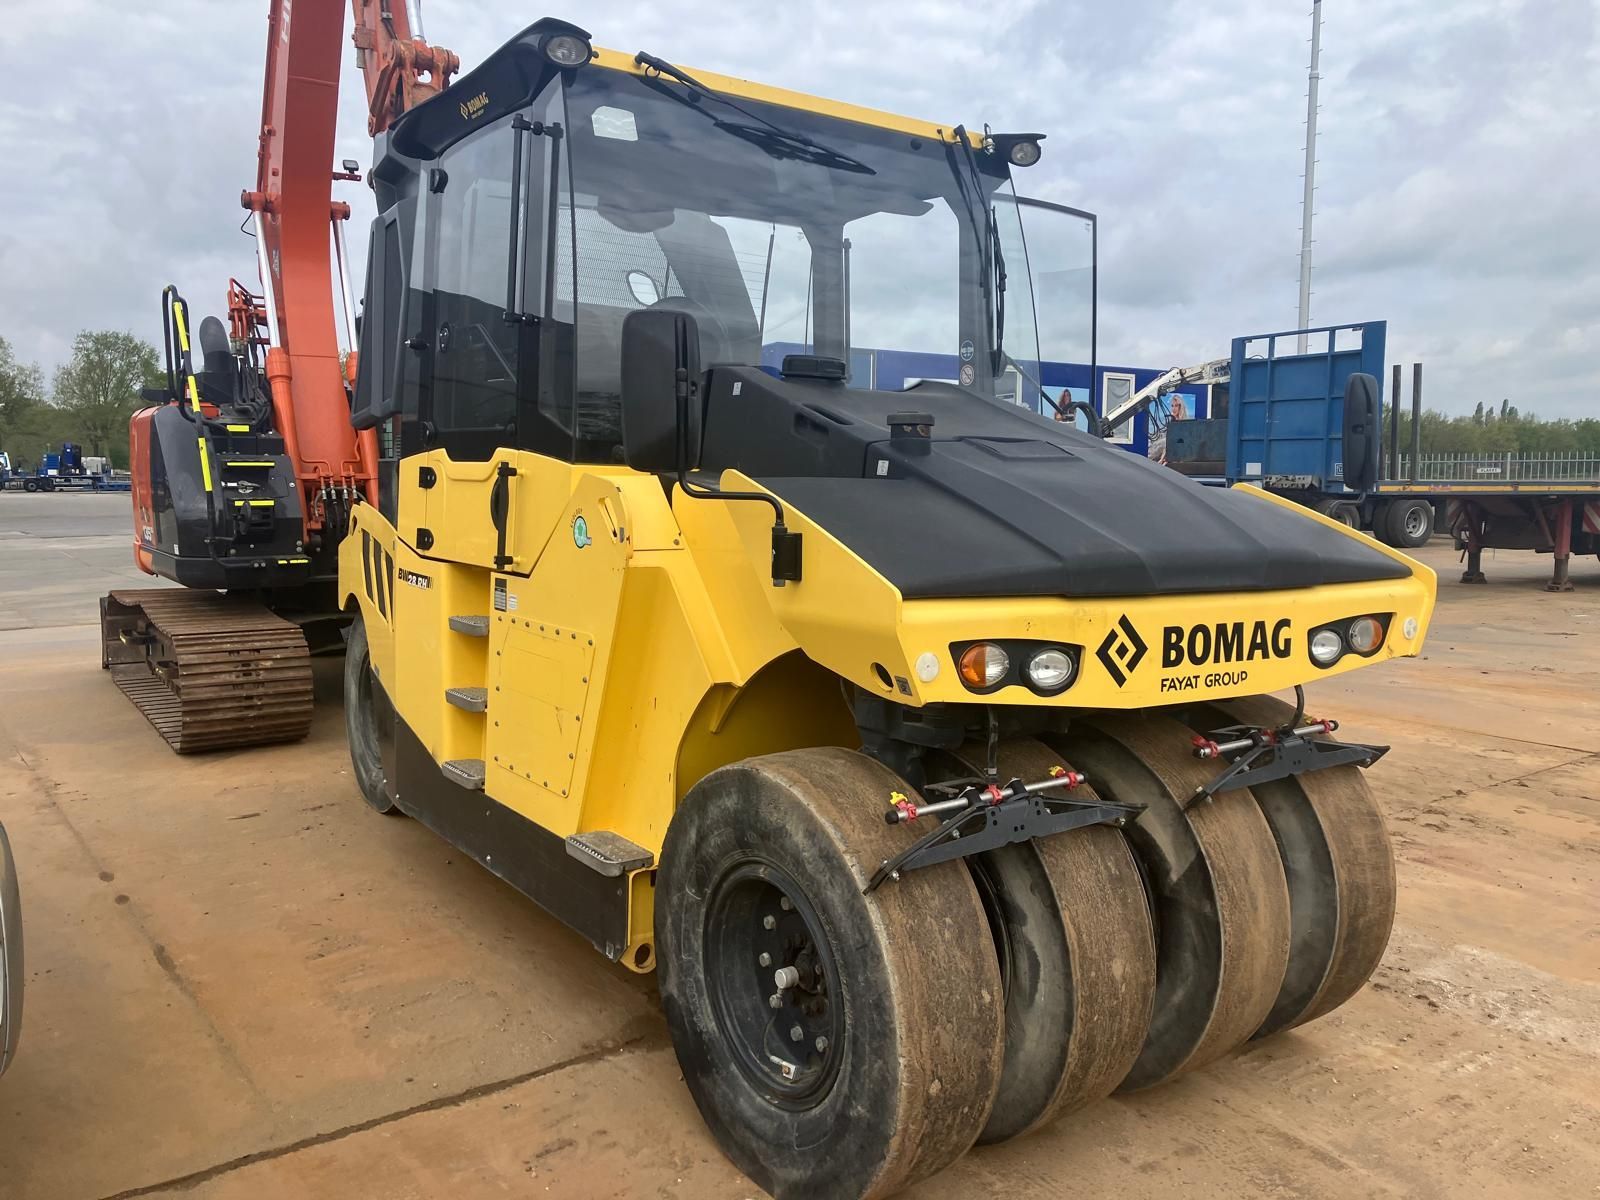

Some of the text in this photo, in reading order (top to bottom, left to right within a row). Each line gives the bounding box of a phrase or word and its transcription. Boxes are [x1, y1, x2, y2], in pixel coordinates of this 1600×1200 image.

[467, 92, 489, 113] BOMAG
[1162, 618, 1292, 668] BOMAG
[1160, 670, 1248, 692] FAYAT GROUP
